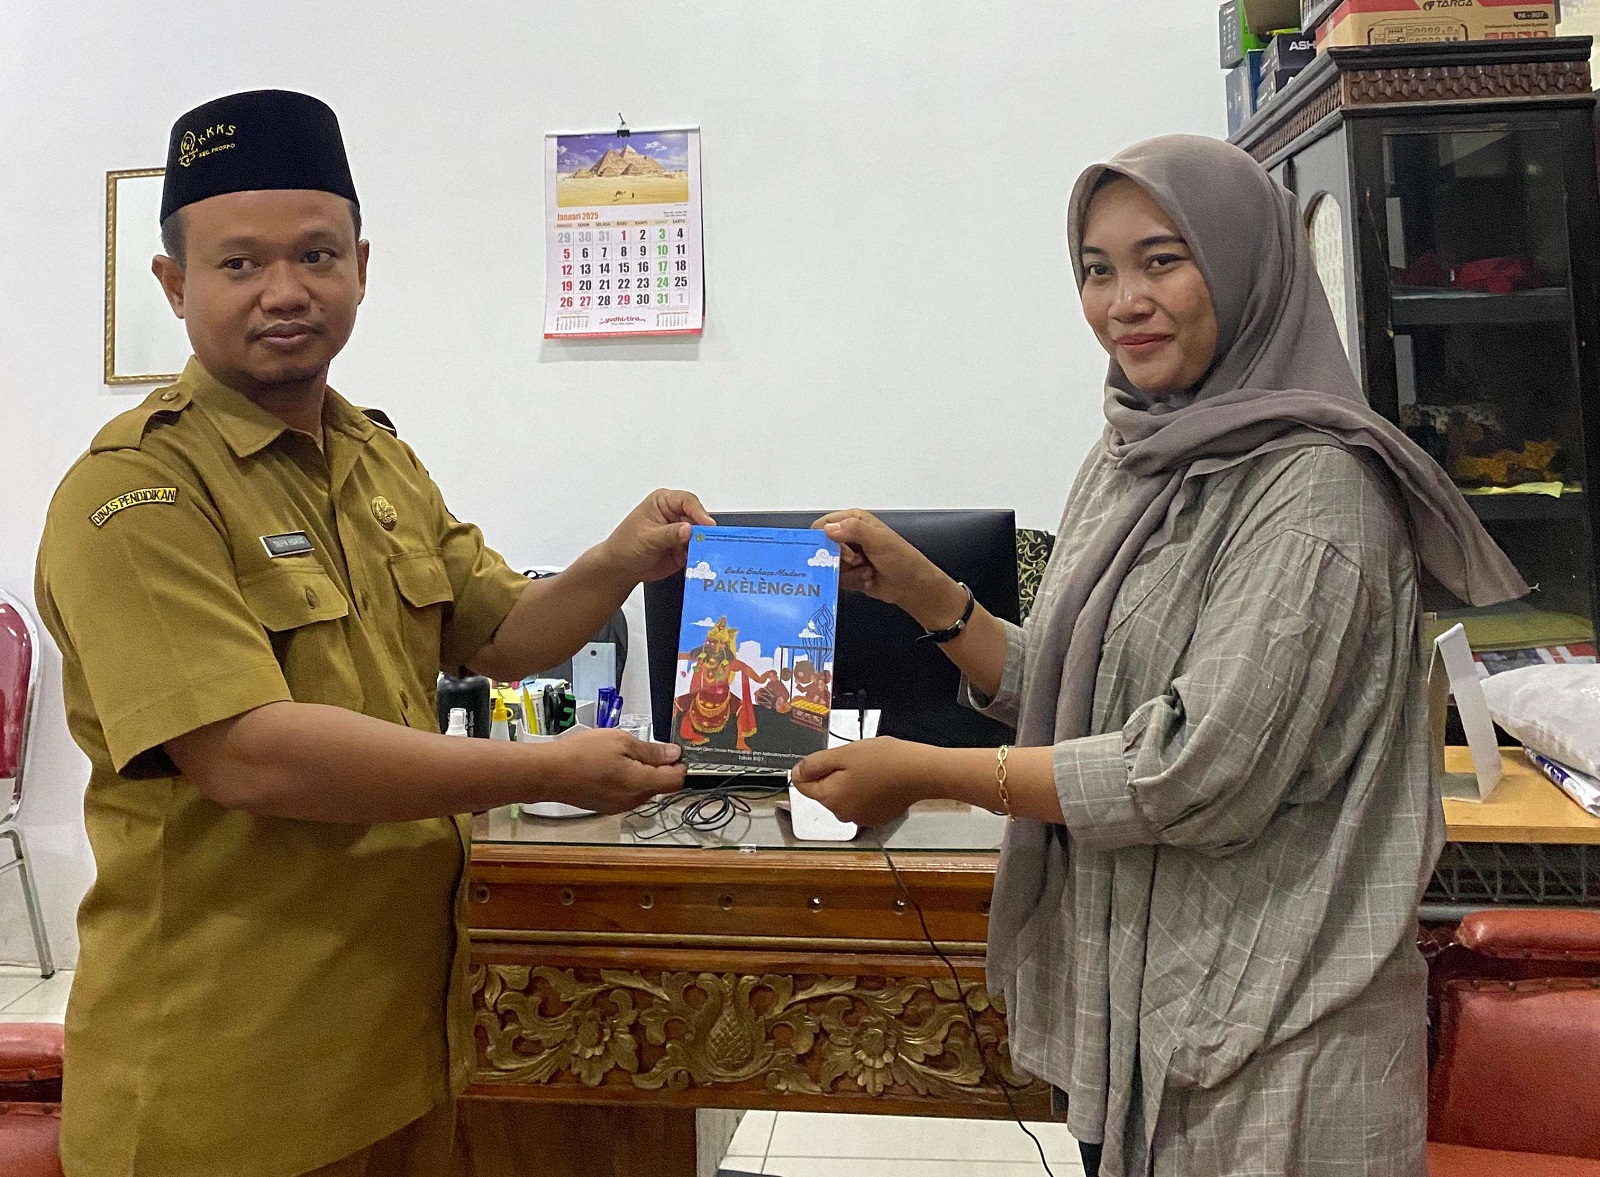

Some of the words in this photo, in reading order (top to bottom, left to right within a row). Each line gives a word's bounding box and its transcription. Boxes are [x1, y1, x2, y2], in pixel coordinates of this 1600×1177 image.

[1436, 0, 1473, 8] TARGA
[197, 123, 236, 145] KKKS
[557, 212, 581, 221] Januari
[582, 211, 599, 221] 2025
[557, 232, 571, 243] 29
[578, 231, 591, 242] 30
[598, 230, 610, 241] 31
[621, 230, 626, 241] 1
[639, 229, 646, 240] 2
[658, 228, 666, 239] 3
[676, 227, 684, 239] 4
[563, 248, 571, 259] 5
[582, 247, 589, 259] 6
[601, 246, 608, 258] 7
[620, 246, 628, 257] 8
[639, 245, 647, 256] 9
[656, 244, 669, 256] 10
[675, 243, 686, 255] 11
[561, 264, 573, 276] 12
[579, 263, 592, 275] 13
[598, 262, 611, 274] 14
[617, 262, 630, 273] 15
[637, 261, 649, 273] 16
[657, 260, 668, 272] 17
[674, 259, 687, 271] 18
[560, 280, 573, 292] 19
[578, 279, 592, 291] 20
[599, 278, 610, 290] 21
[617, 278, 631, 289] 22
[636, 277, 650, 289] 23
[656, 276, 669, 288] 24
[674, 276, 688, 287] 25
[559, 296, 573, 308] 26
[579, 295, 592, 307] 27
[597, 294, 611, 306] 28
[616, 294, 631, 306] 29
[636, 293, 650, 305] 30
[656, 293, 669, 305] 31
[677, 292, 684, 304] 1
[92, 501, 119, 525] DINAS
[118, 489, 175, 508] PENDIDIKAN
[724, 566, 745, 575] Buku
[703, 577, 821, 598] PAKÈLÈNGAN
